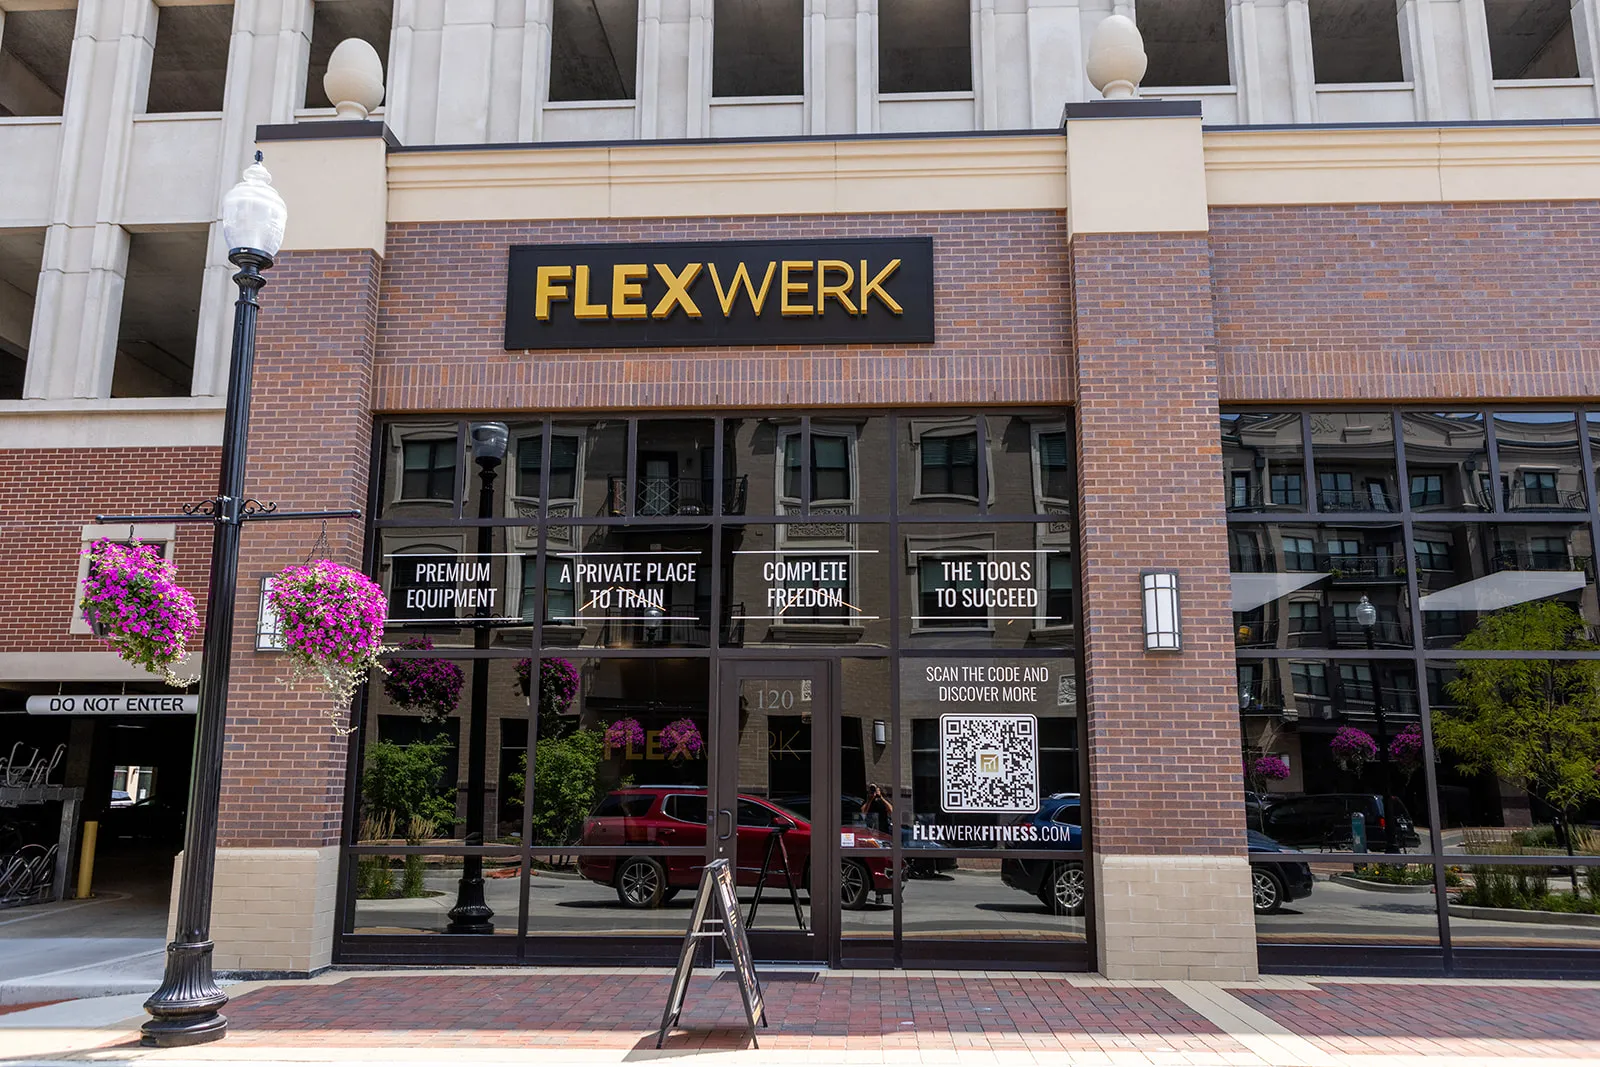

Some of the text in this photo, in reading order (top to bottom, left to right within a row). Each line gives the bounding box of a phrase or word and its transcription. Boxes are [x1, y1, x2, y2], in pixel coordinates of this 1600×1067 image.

[535, 259, 903, 321] FLEXWERK
[415, 562, 491, 584] PREMIUM
[560, 561, 697, 584] A PRIVATE PLACE
[763, 561, 848, 582] COMPLETE
[941, 561, 1031, 582] THE TOOLS
[406, 588, 498, 611] EQUIPMENT
[590, 588, 664, 609] TO TRAIN
[767, 587, 843, 608] FREEDOM
[935, 587, 1038, 608] TO SUCCEED
[926, 666, 1049, 682] SCAN THE CODE AND
[50, 697, 184, 712] DO NOT ENTER
[757, 689, 794, 710] 120
[939, 686, 1037, 702] DISCOVER MORE
[603, 729, 801, 761] FLEXERK
[913, 824, 1071, 842] FLEXWERKFITNESS.COM
